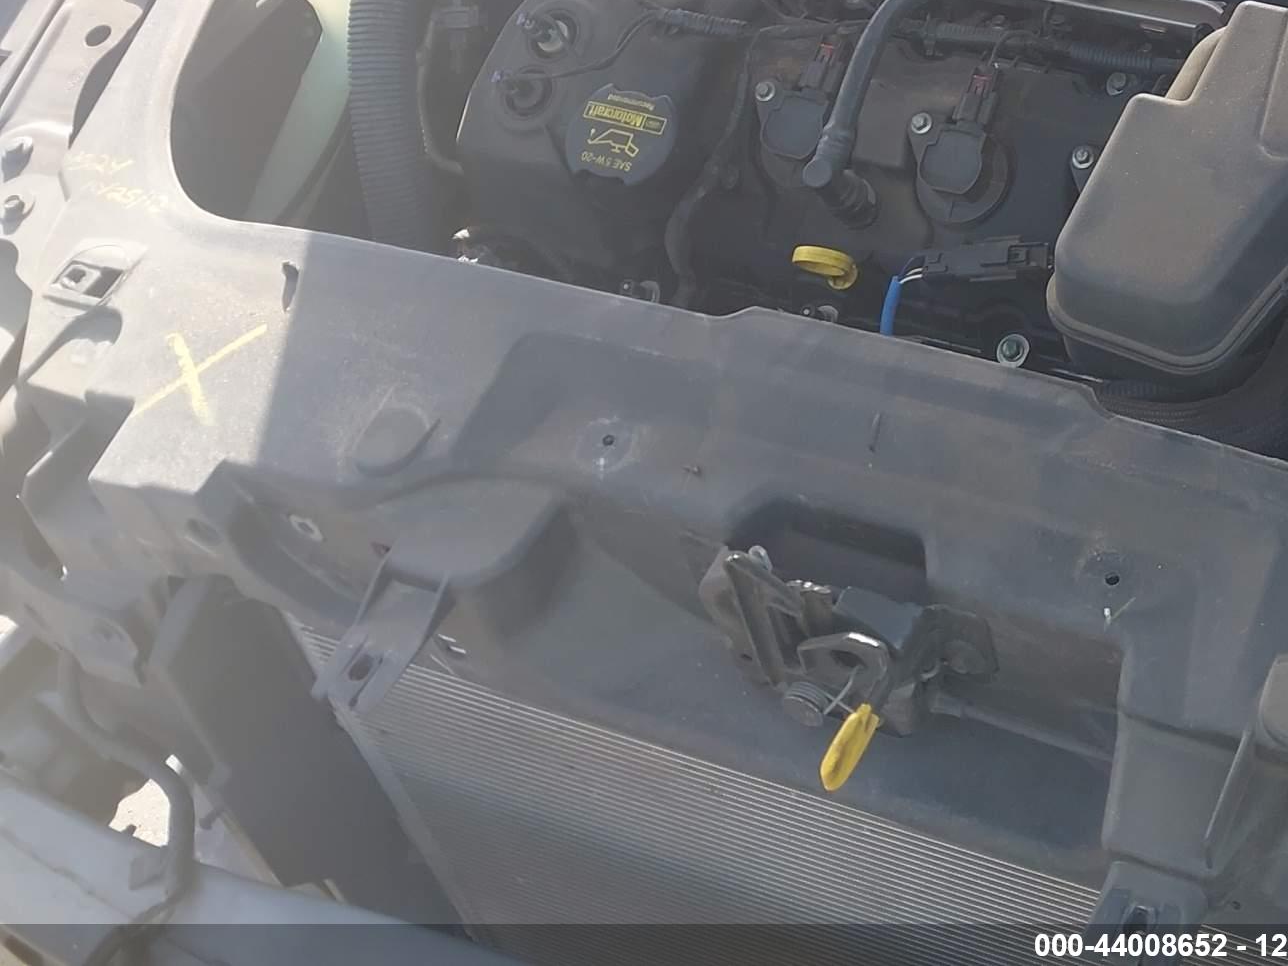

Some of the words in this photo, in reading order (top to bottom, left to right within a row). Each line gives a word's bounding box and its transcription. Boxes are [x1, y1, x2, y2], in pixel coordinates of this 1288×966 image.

[588, 104, 644, 127] Motorcraft
[580, 151, 613, 168] 5W-20
[612, 159, 633, 172] SAE
